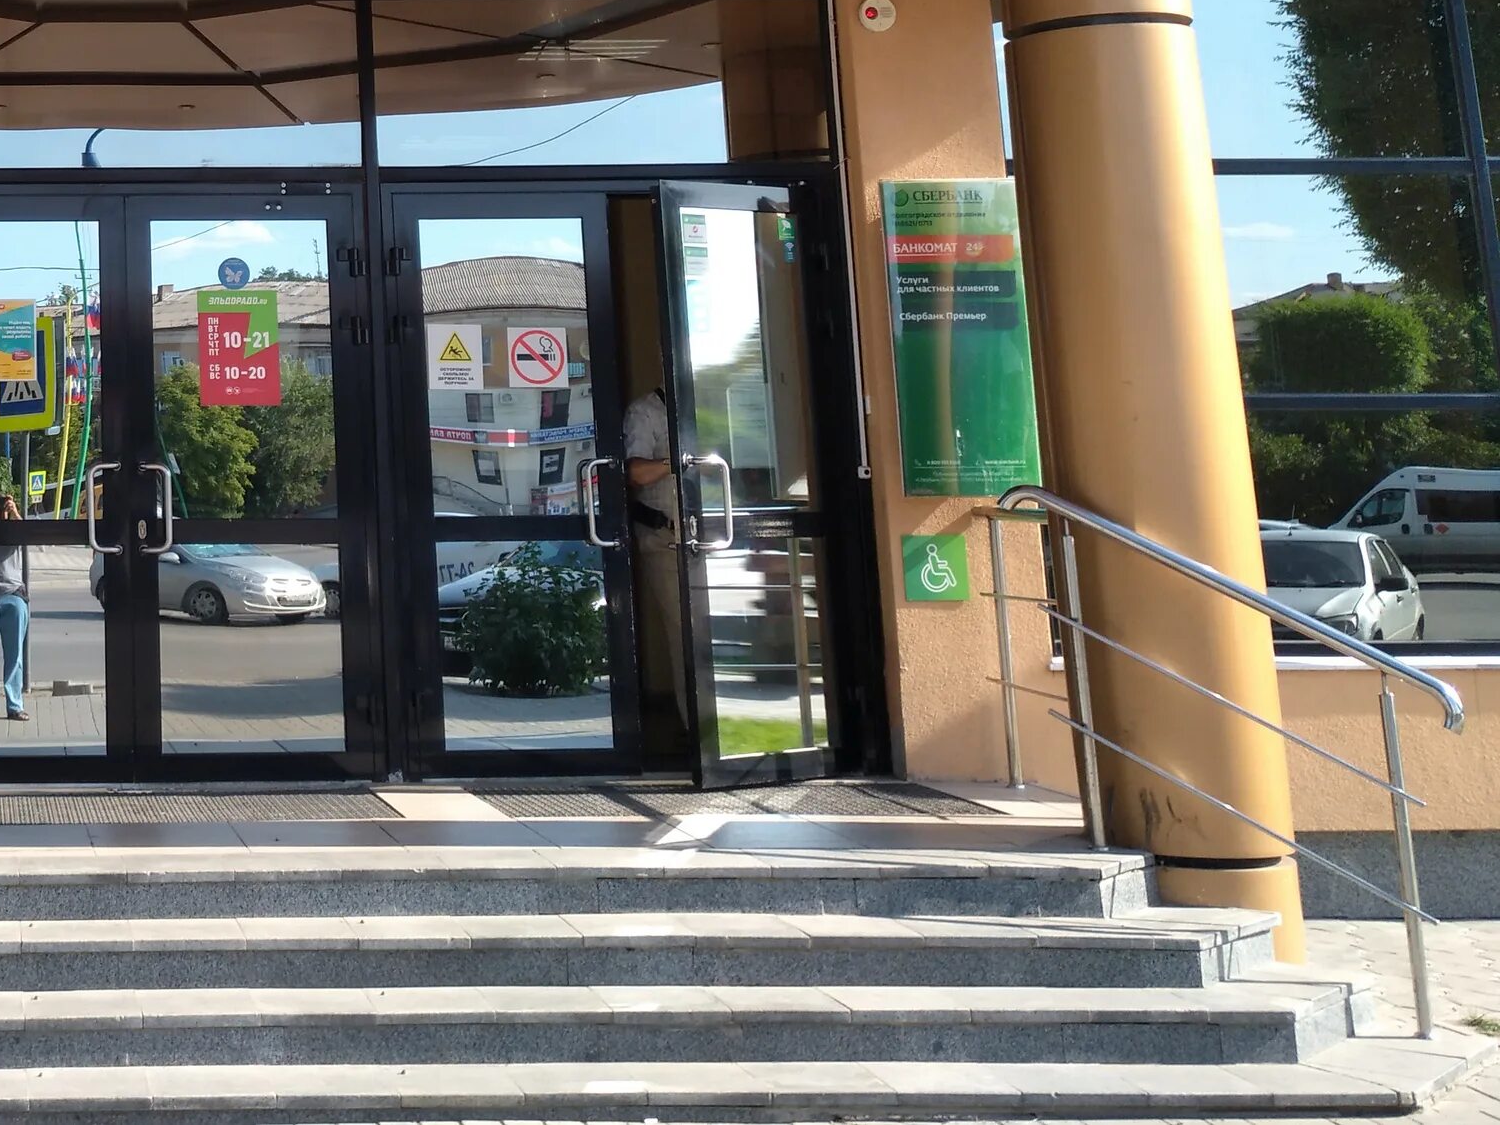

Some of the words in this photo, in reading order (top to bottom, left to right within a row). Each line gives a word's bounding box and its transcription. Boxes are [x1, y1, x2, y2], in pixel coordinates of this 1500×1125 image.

[912, 189, 984, 202] СБЕРБАНК
[893, 242, 958, 254] БАНКОМАТ
[896, 276, 929, 286] Услуги
[896, 286, 915, 294] для
[916, 285, 954, 293] частных
[956, 285, 1000, 293] клиентов
[207, 317, 219, 325] ПН
[899, 311, 945, 322] Сбербанк
[946, 312, 987, 321] Премьер
[208, 325, 219, 333] ВТ
[208, 333, 219, 341] СР
[223, 331, 270, 349] 10-21
[208, 348, 220, 356] ПТ
[209, 364, 221, 372] СБ
[209, 372, 221, 380] ВС
[224, 366, 266, 380] 10-20
